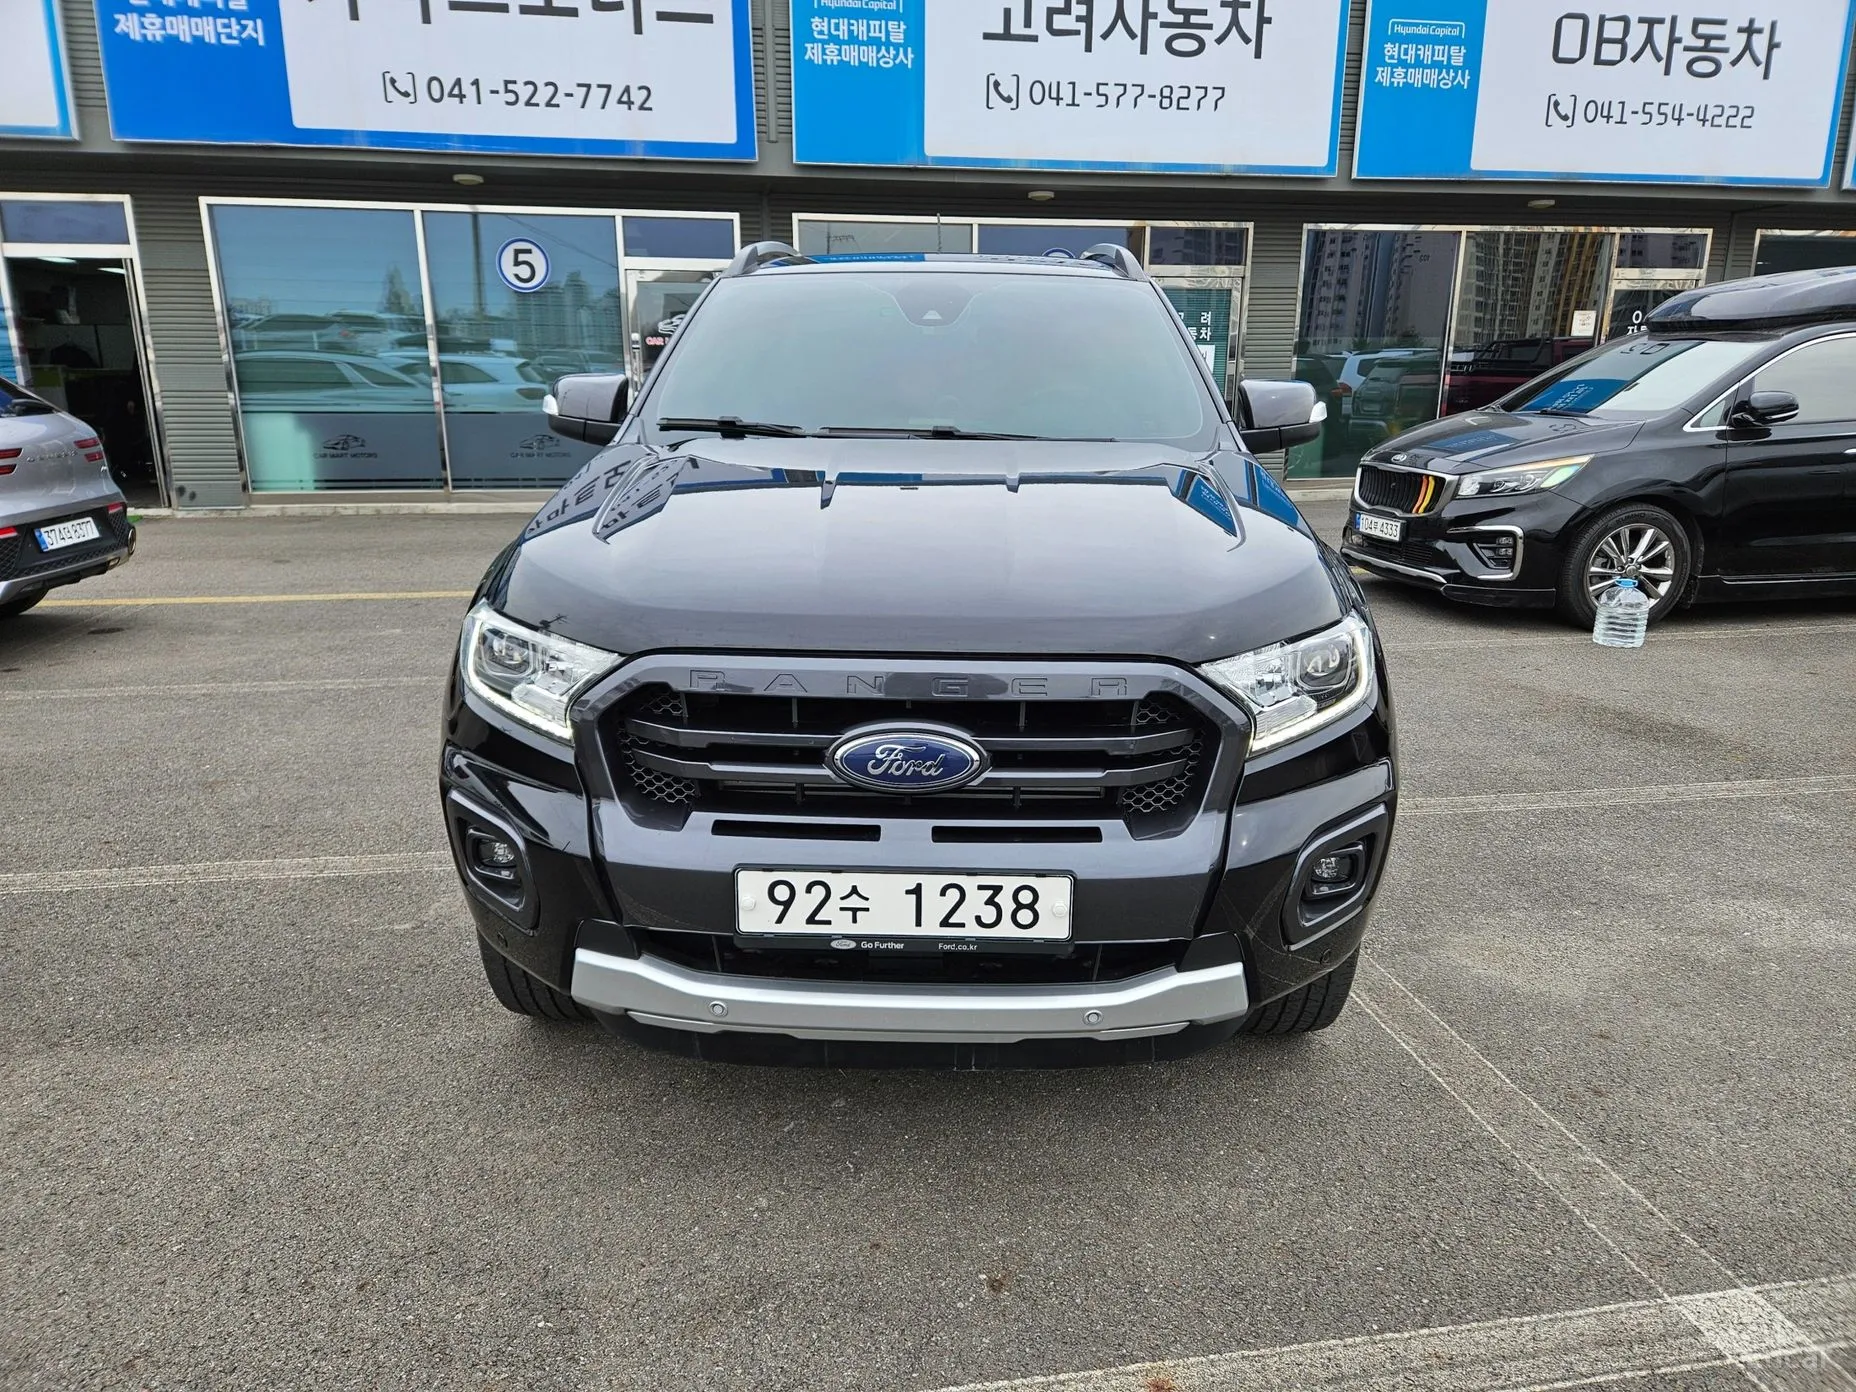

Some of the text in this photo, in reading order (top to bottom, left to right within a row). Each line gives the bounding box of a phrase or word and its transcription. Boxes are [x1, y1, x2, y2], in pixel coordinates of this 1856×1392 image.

[113, 12, 265, 46] 제휴매매단지
[810, 16, 907, 43] 현대캐피탈
[982, 0, 1273, 60] 고려자동차
[1394, 24, 1460, 37] Hyundai Capital
[804, 42, 915, 69] 제휴매매상사
[1384, 42, 1466, 66] 현대캐피탈
[1551, 12, 1783, 81] OB자동차
[1374, 66, 1471, 90] 제휴매매상사
[427, 76, 653, 111] 041-522-7742
[1028, 79, 1227, 112] 041-577-8277
[1583, 99, 1755, 129] 041-554-4222
[512, 248, 536, 284] 5
[1200, 311, 1212, 326] 려
[1380, 521, 1398, 538] 4333
[689, 669, 1128, 697] RANGER
[866, 743, 944, 778] Ford
[767, 879, 1040, 930] 92수 1238
[860, 941, 873, 949] Go
[874, 941, 905, 949] Further
[938, 942, 978, 950] Ford.co.kr
